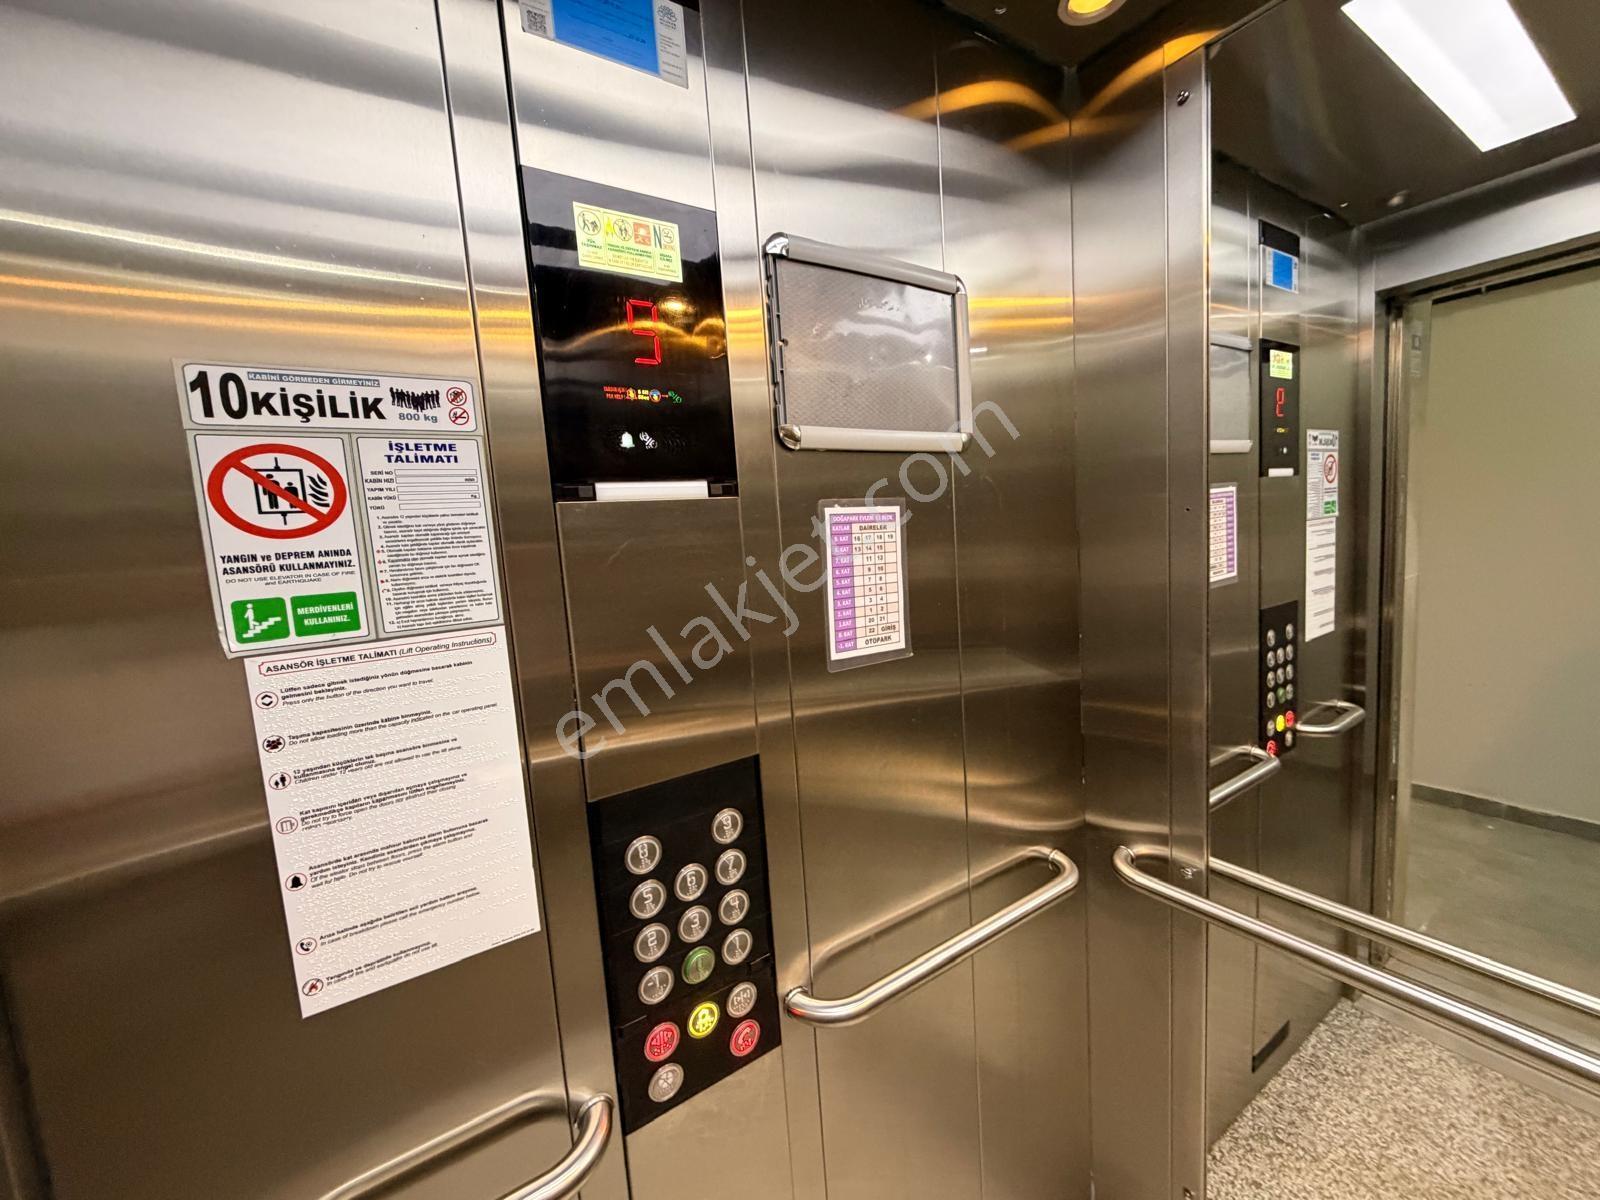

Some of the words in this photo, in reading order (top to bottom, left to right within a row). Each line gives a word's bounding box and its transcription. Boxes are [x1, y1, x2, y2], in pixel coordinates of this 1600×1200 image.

[626, 299, 661, 365] 9
[249, 373, 280, 381] KABİNİ
[282, 375, 330, 384] GÖRMEDEN
[189, 371, 248, 419] 10
[251, 387, 386, 423] KİŞİLİK
[399, 412, 420, 421] 800
[424, 413, 438, 423] kg
[389, 440, 457, 453] İŞLETME
[384, 453, 458, 463] TALİMATI
[220, 554, 257, 564] YANGIN
[275, 551, 314, 561] DEPREM
[318, 549, 352, 558] ANINDA
[222, 563, 276, 575] ASANSÖRÜ
[279, 560, 355, 572] KULLANMAYINIZ.
[297, 602, 354, 615] MERDİVENLERİ
[304, 615, 351, 626] KULLANINIZ.
[881, 624, 897, 632] GİRİŞ
[865, 635, 892, 645] OTOPARK
[265, 660, 314, 673] ASANSÖR
[316, 654, 356, 666] İŞLETME
[358, 648, 397, 660] TALİMATI
[399, 647, 414, 655] (Lift
[415, 643, 449, 653] Operating
[451, 637, 492, 648] Instructions)
[722, 815, 732, 830] 9
[638, 843, 648, 859] 8
[686, 871, 696, 887] 6
[642, 887, 653, 904] 5
[729, 897, 739, 908] 4
[691, 914, 700, 928] 3
[648, 931, 657, 947] 2
